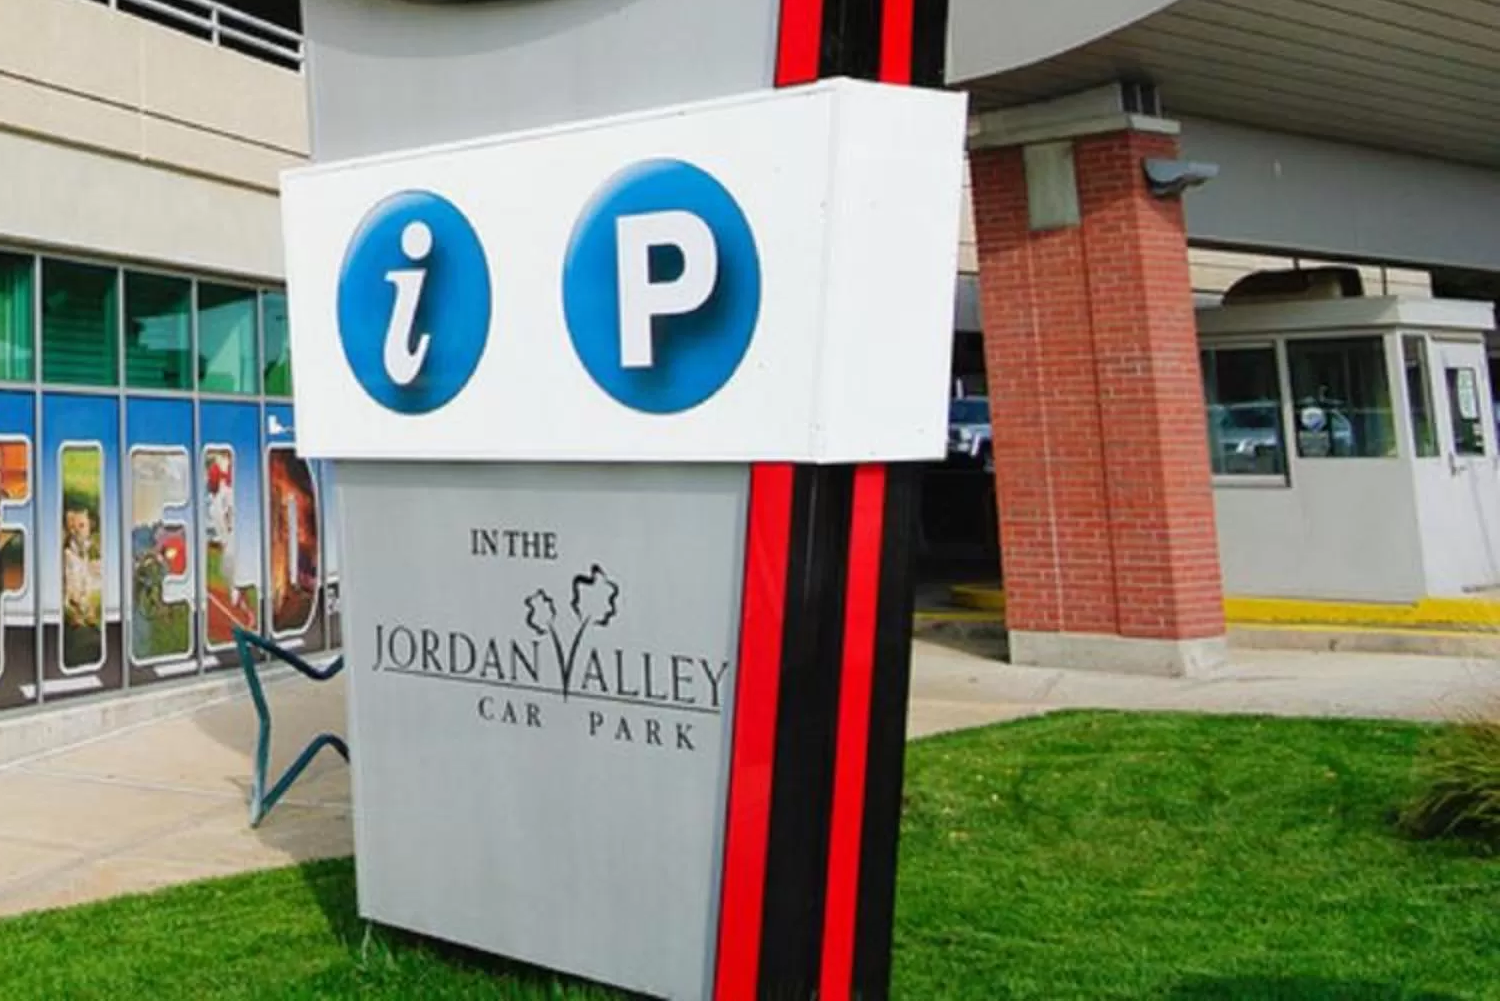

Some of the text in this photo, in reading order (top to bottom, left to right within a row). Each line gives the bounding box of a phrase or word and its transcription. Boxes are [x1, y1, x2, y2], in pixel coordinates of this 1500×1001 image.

[615, 209, 719, 368] P
[470, 528, 559, 560] IN THE
[372, 616, 731, 708] JORDAN VALLEY
[477, 697, 697, 751] CAR PARK
